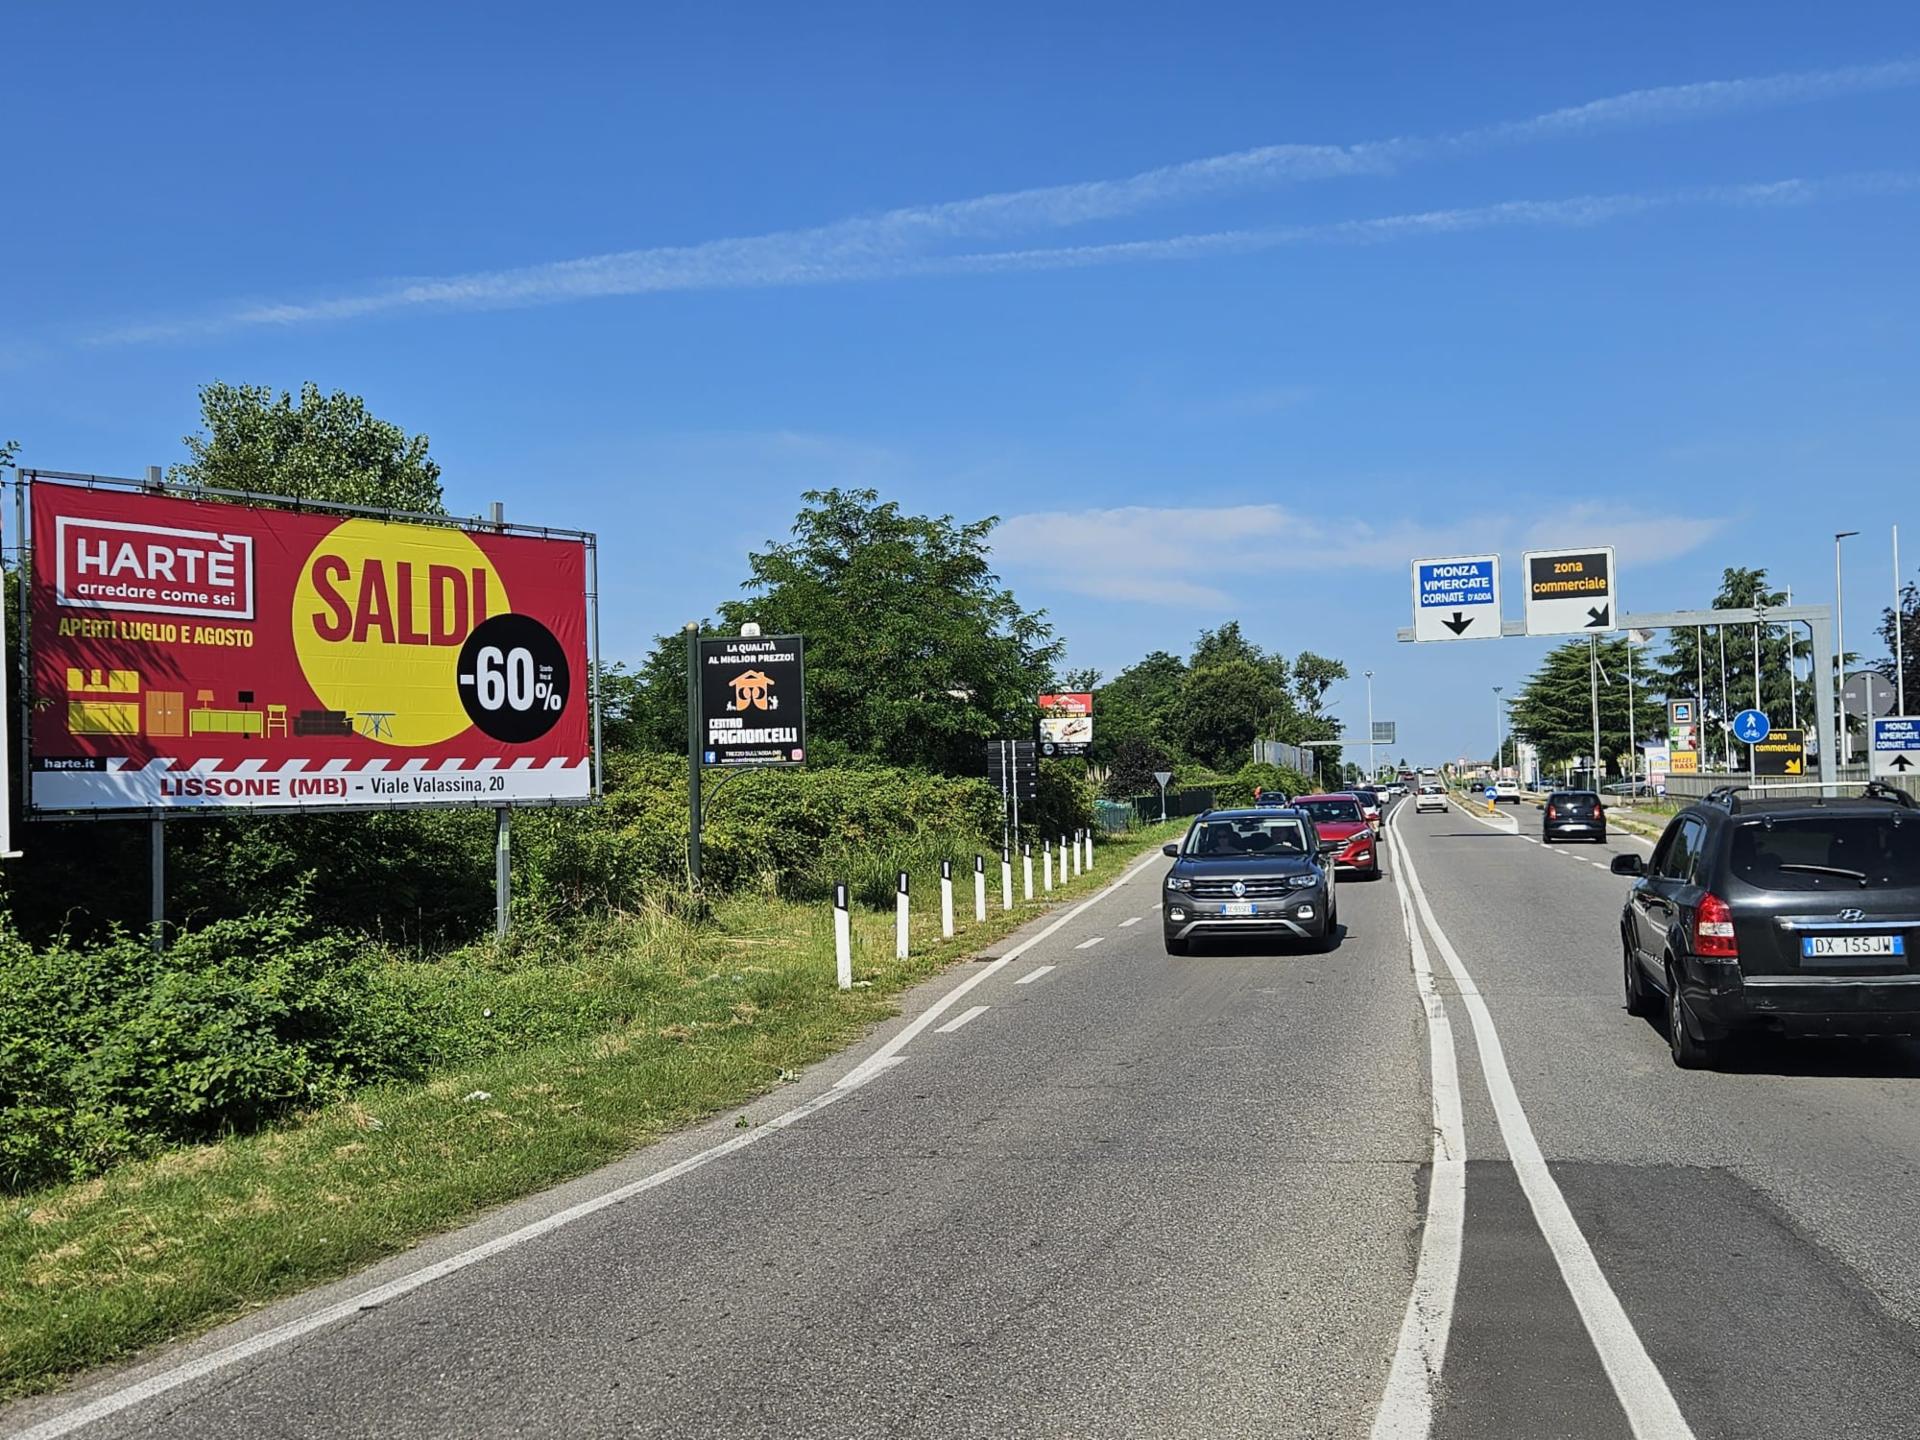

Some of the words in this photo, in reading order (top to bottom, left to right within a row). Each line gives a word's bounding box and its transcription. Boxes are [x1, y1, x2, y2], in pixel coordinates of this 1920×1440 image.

[77, 533, 235, 587] HARTÈ
[1433, 565, 1479, 578] MONZA
[1553, 561, 1583, 574] zona
[1424, 577, 1490, 590] VIMERCATE
[1533, 578, 1606, 593] commerciale
[78, 582, 156, 599] arredare
[161, 591, 207, 604] come
[213, 592, 235, 606] sei
[312, 554, 487, 646] SALDI
[1422, 592, 1464, 604] CORNATE
[1467, 592, 1492, 601] D'ADDA
[59, 618, 116, 639] APERTI
[122, 622, 176, 643] LUGLIO
[181, 626, 190, 643] E
[194, 626, 253, 647] AGOSTO
[727, 644, 737, 652] LA
[739, 641, 776, 653] QUALITÀ
[720, 655, 756, 664] MIGLIOR
[758, 653, 794, 662] PREZZO!
[709, 718, 743, 729] CENTRO
[1884, 722, 1913, 730] MONZA
[709, 727, 797, 745] PAGNONCELLI
[1768, 733, 1787, 741] zona
[1879, 731, 1920, 740] VIMERCATE
[1755, 742, 1801, 752] commerciale
[1876, 741, 1906, 749] CORNATE
[44, 758, 95, 770] harte.it
[160, 778, 281, 797] LISSONE
[289, 777, 347, 797] (MB)
[371, 777, 409, 793] Viale
[412, 777, 486, 794] Valassina,
[489, 776, 505, 791] 20
[1815, 938, 1834, 953] DX
